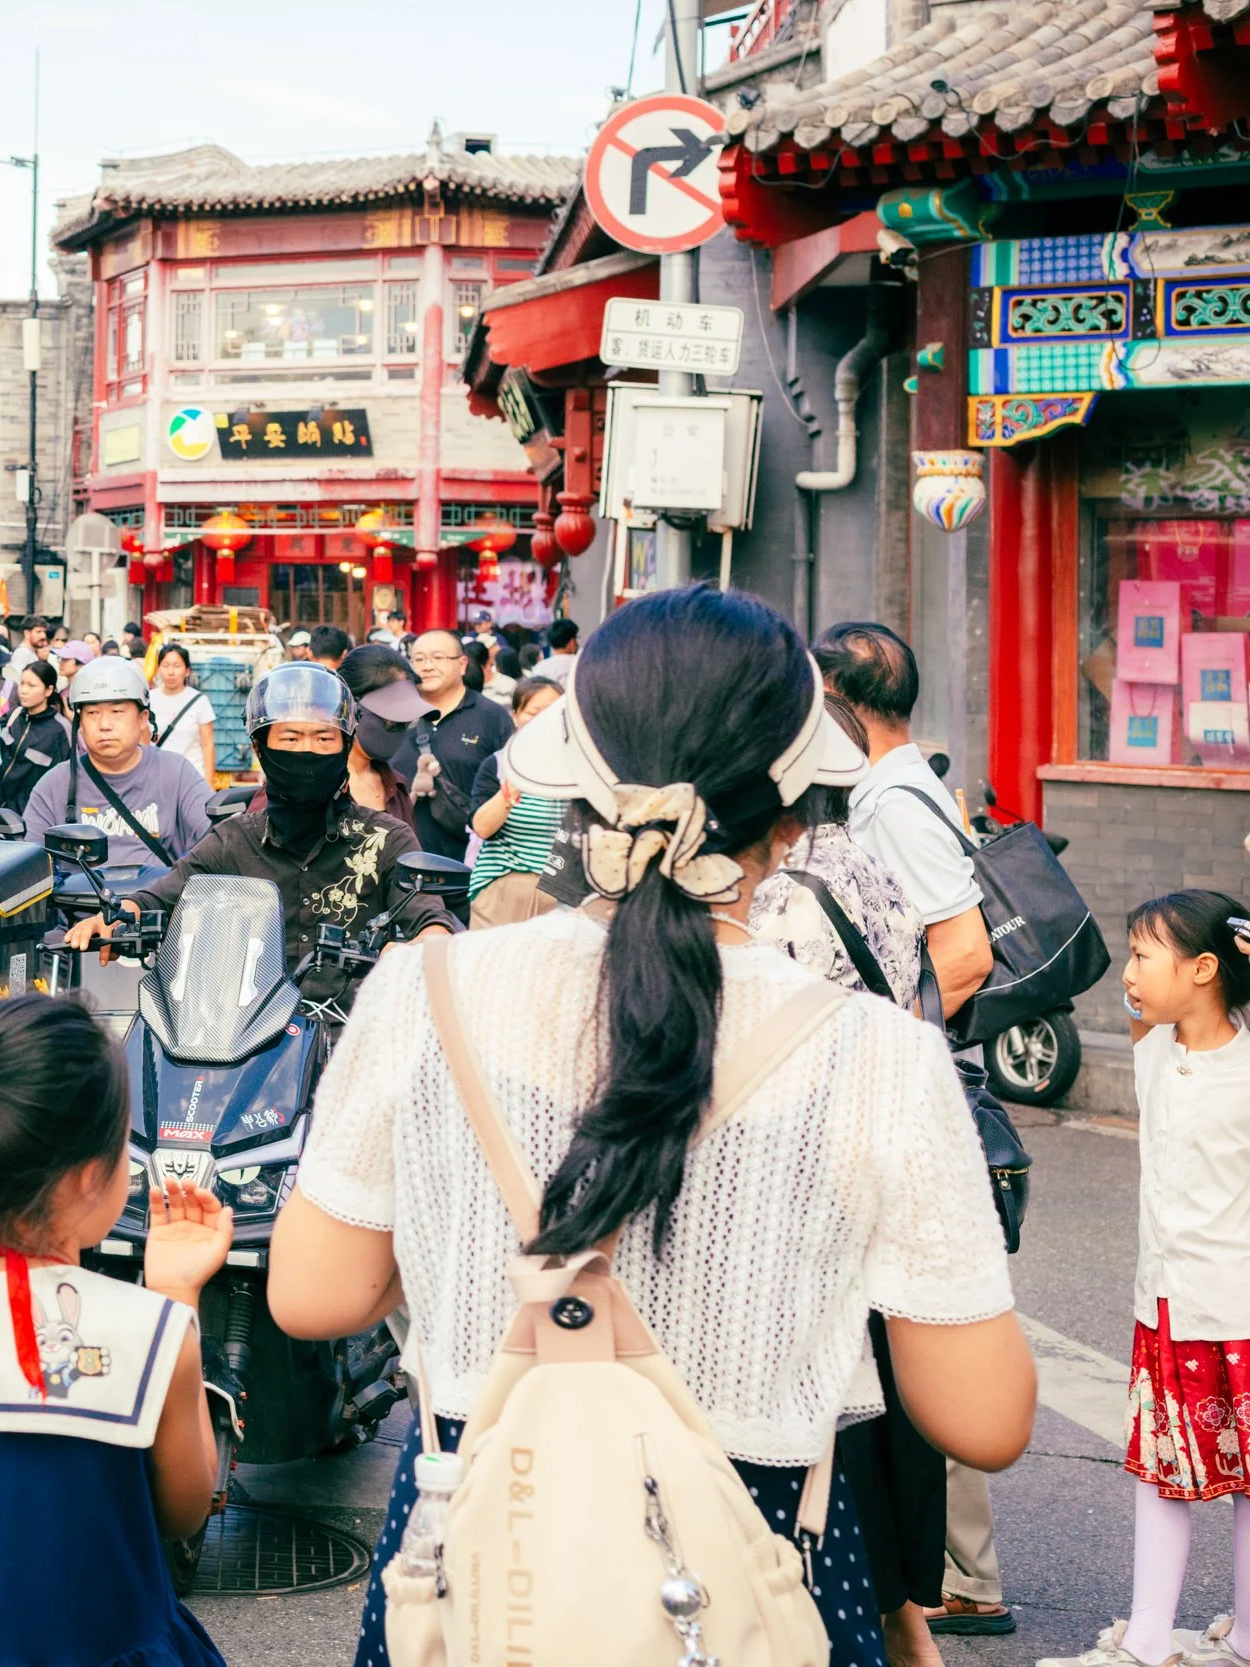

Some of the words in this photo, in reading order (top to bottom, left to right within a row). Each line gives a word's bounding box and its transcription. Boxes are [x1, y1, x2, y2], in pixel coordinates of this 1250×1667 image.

[634, 308, 714, 331] 机动车
[186, 1080, 203, 1123] SCOOTER
[163, 1129, 206, 1140] MAX
